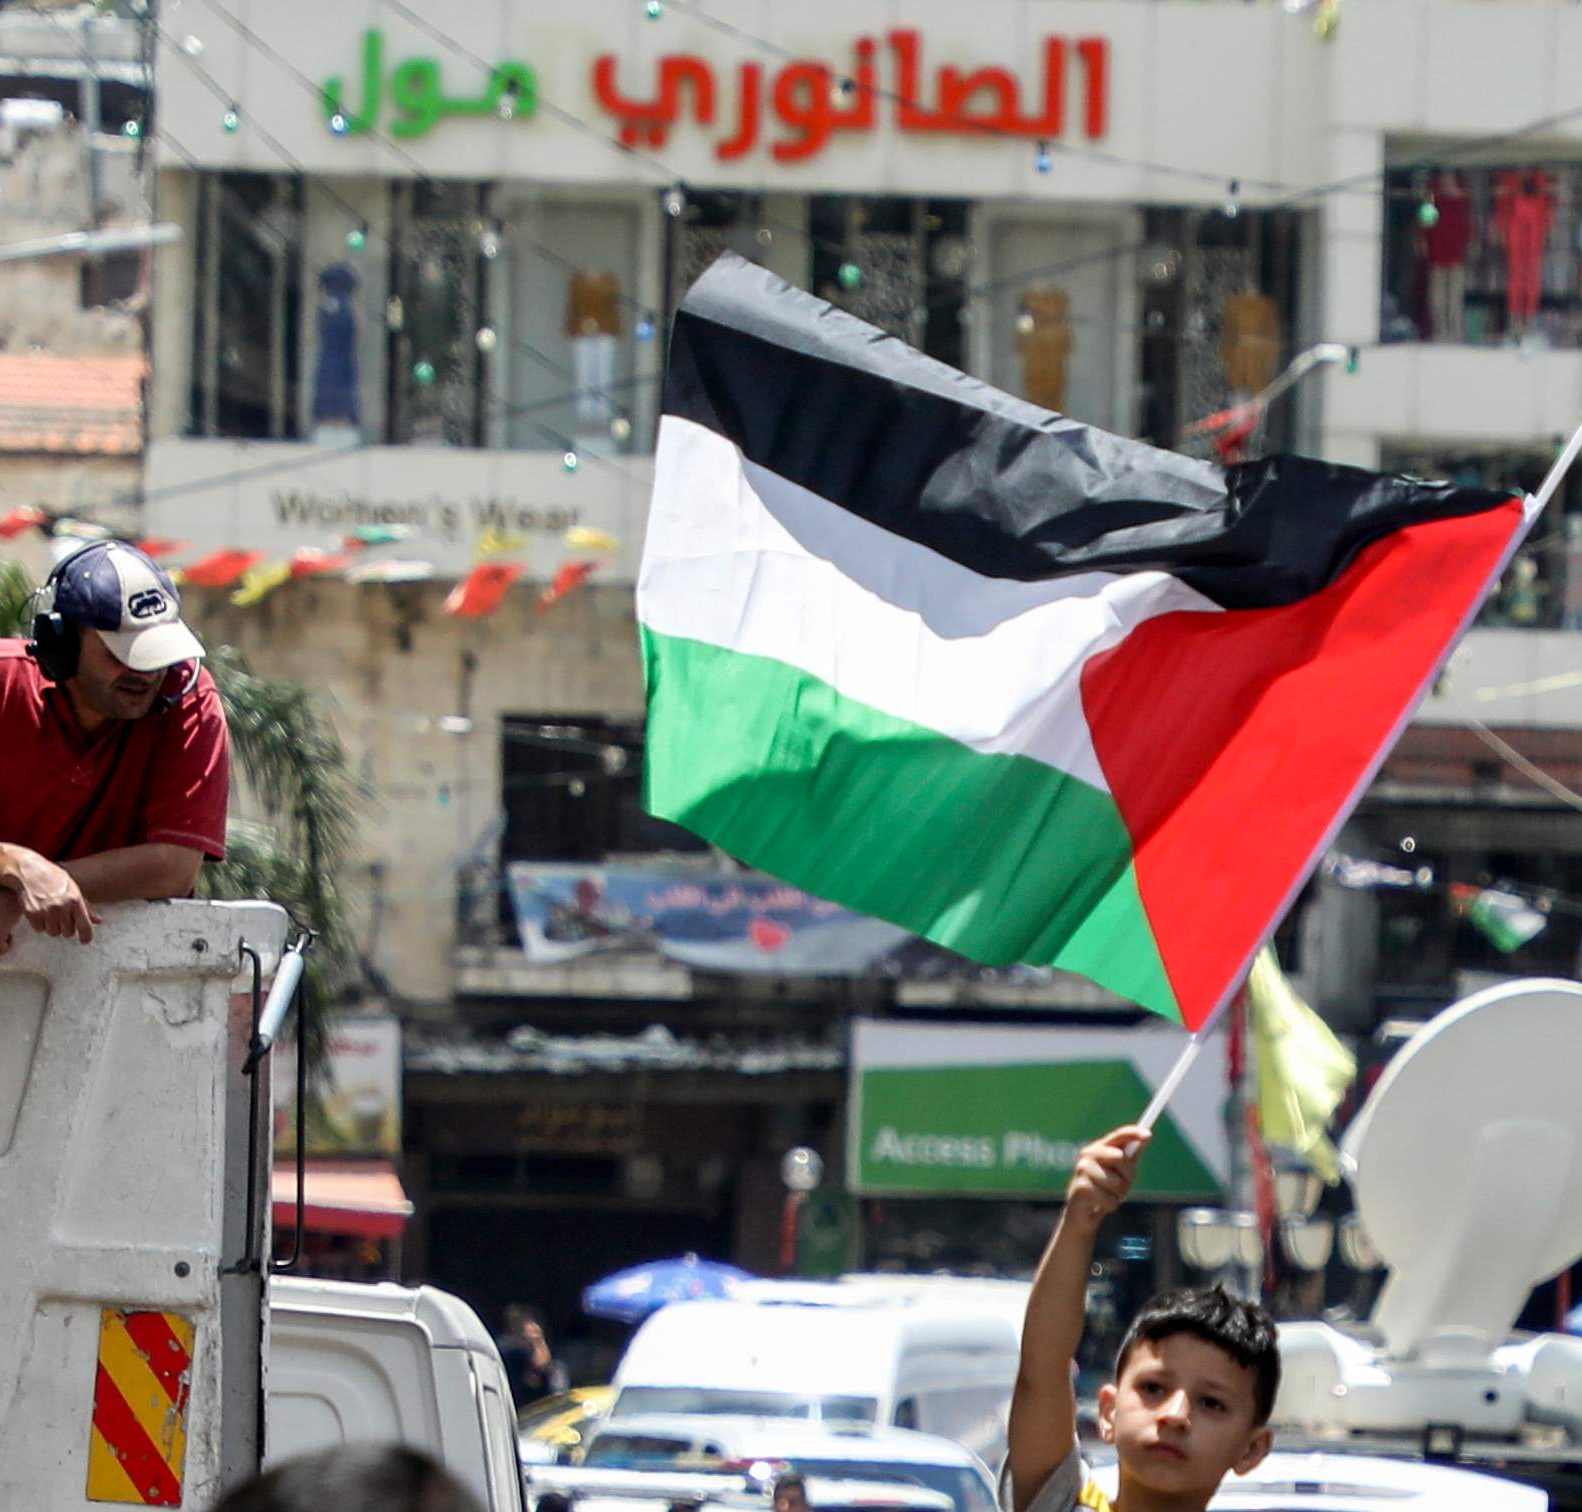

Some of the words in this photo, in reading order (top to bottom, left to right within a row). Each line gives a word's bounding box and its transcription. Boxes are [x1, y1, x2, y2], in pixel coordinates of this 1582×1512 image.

[324, 29, 539, 138] مول
[592, 29, 1108, 164] الصانوري
[871, 1126, 996, 1169] Access
